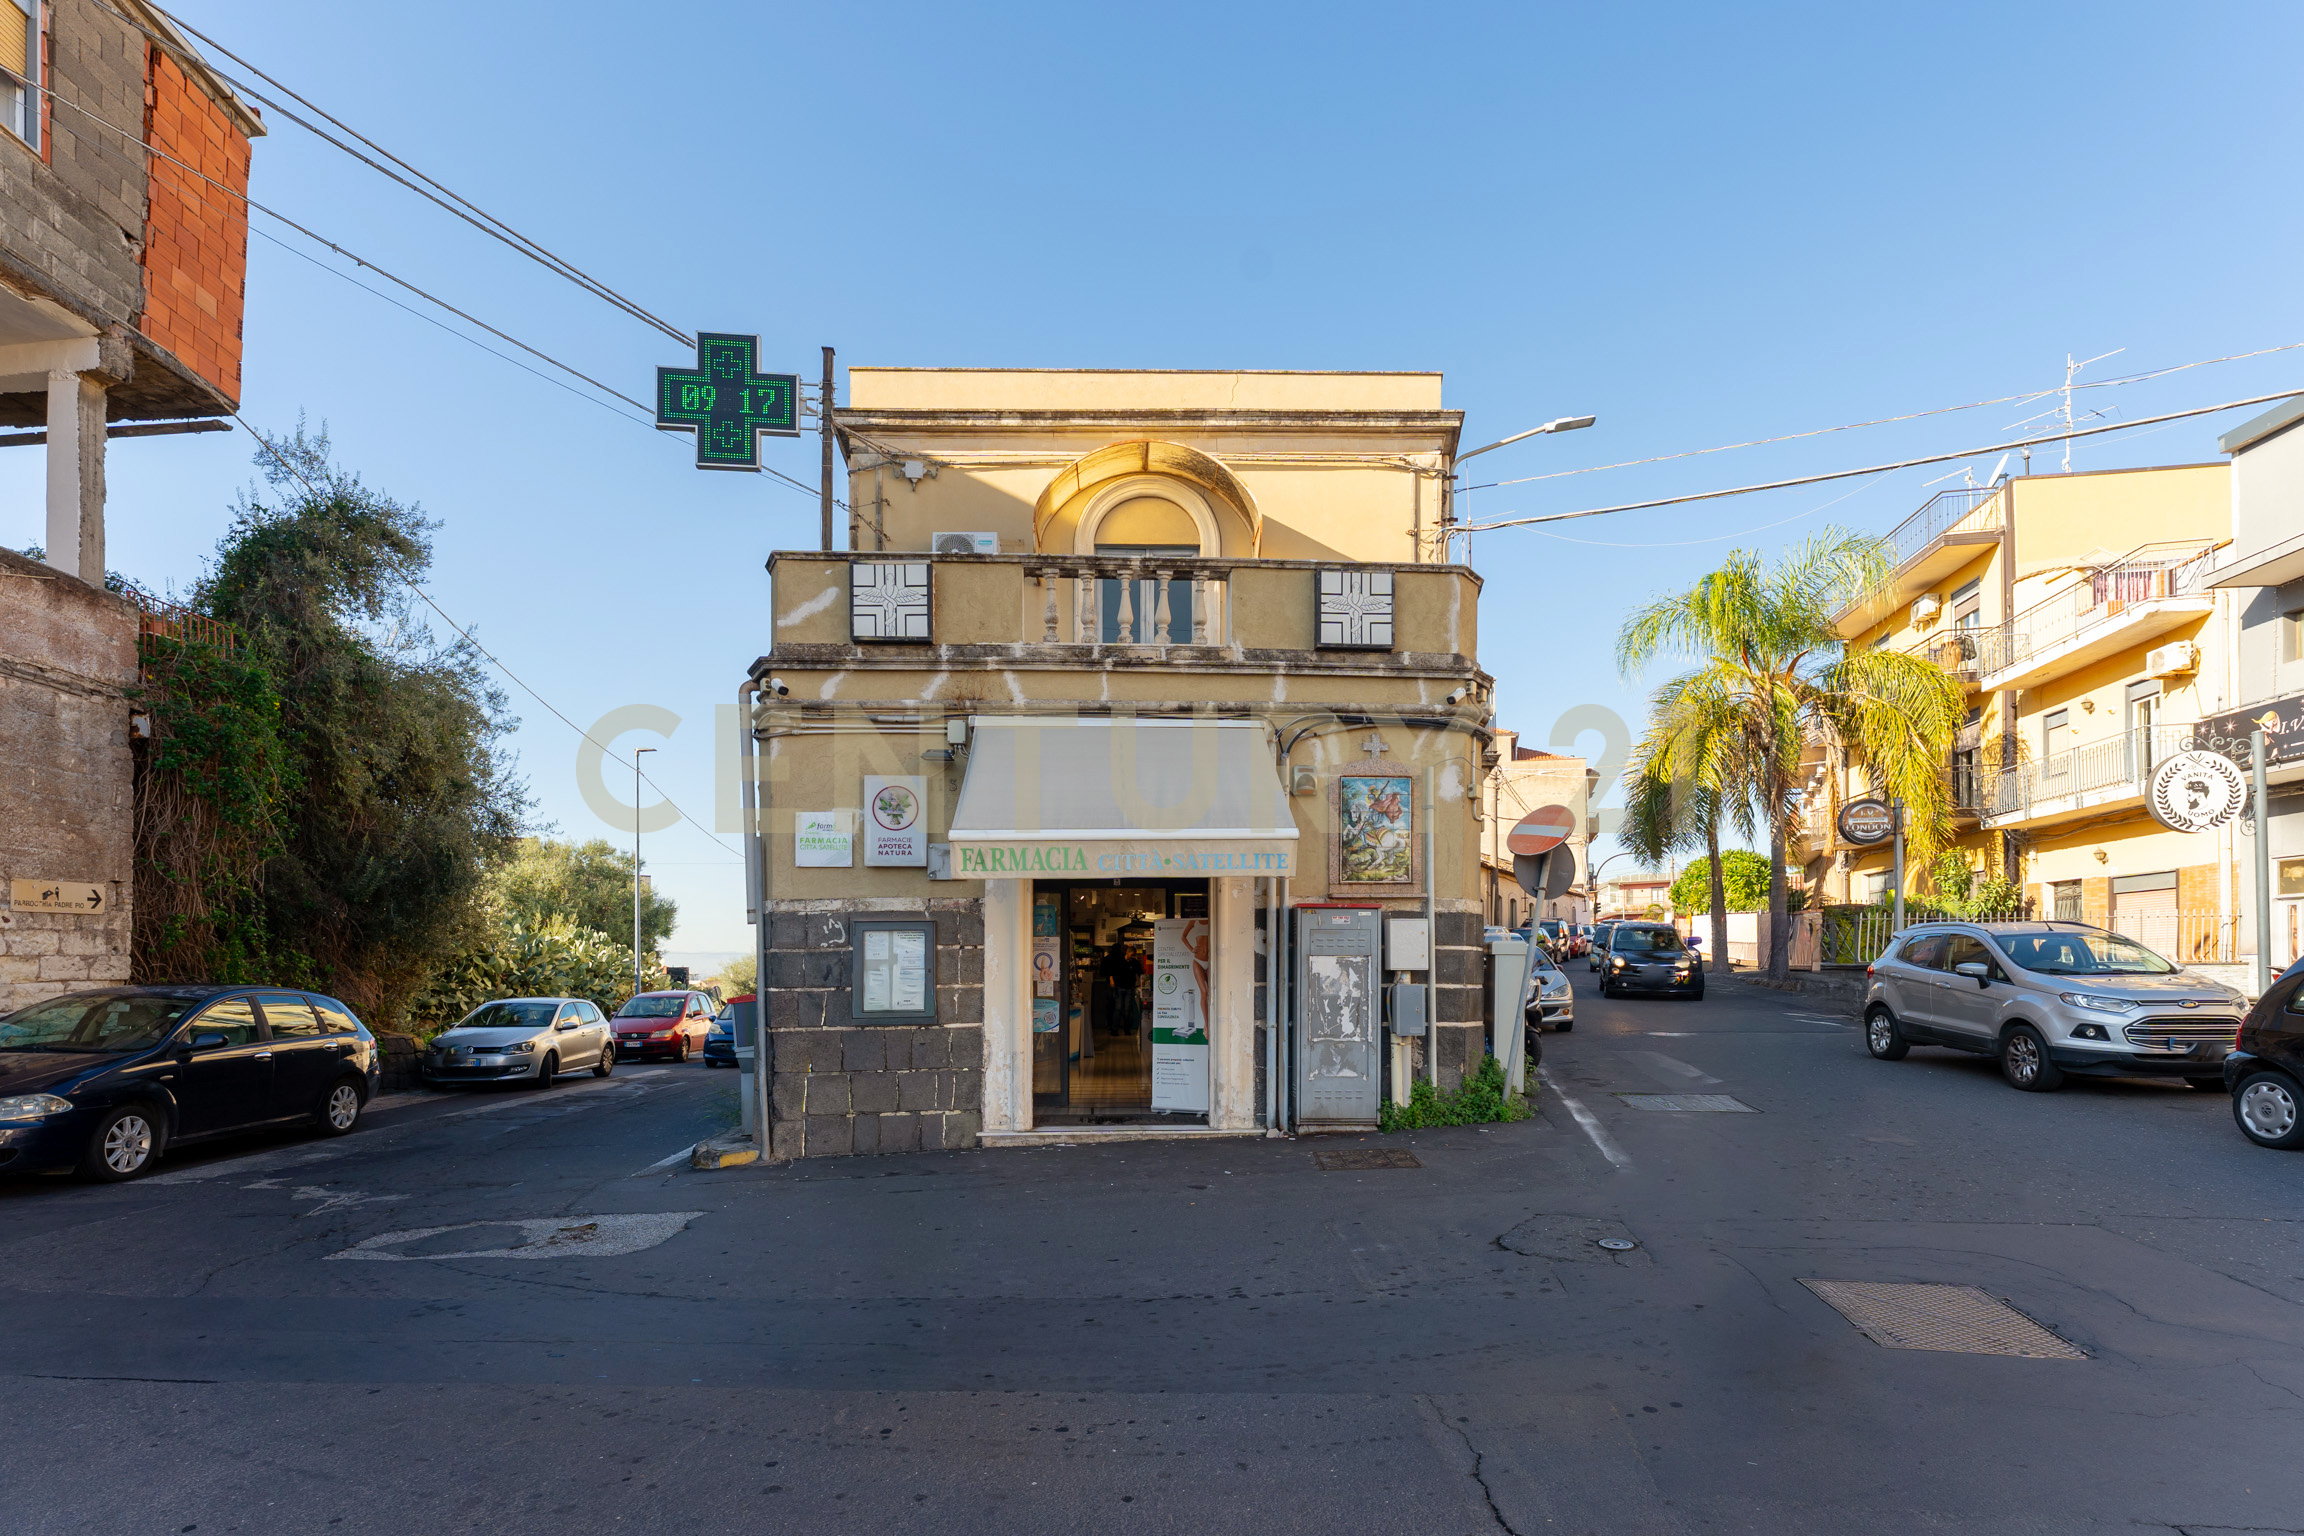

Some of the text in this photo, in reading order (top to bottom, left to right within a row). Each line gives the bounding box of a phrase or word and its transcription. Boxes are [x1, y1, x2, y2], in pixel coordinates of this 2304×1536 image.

[682, 384, 775, 414] 09 17
[2187, 808, 2215, 818] UOMO
[1845, 823, 1891, 832] LONDON
[960, 847, 1088, 872] FARMACIA
